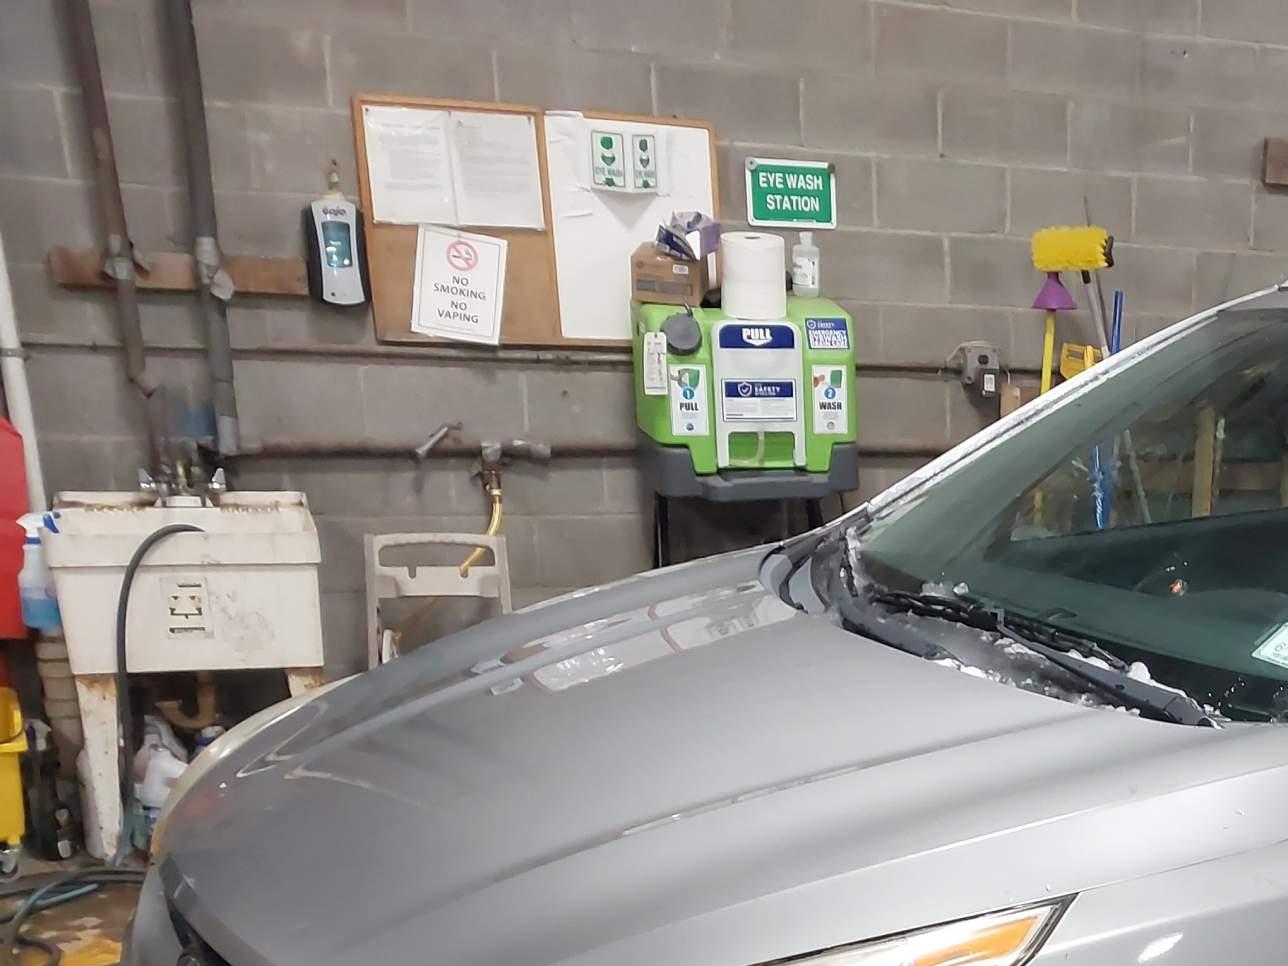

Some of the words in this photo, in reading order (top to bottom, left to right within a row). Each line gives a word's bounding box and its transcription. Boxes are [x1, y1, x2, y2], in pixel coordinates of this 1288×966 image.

[758, 172, 784, 188] EYE
[785, 173, 823, 191] WASH
[766, 194, 820, 212] STATION
[452, 275, 469, 287] NO
[433, 282, 487, 301] SMOKING
[450, 300, 468, 311] NO
[437, 308, 479, 324] VAPING
[742, 327, 773, 341] PULL
[679, 402, 699, 412] PULL
[819, 401, 843, 411] WASH
